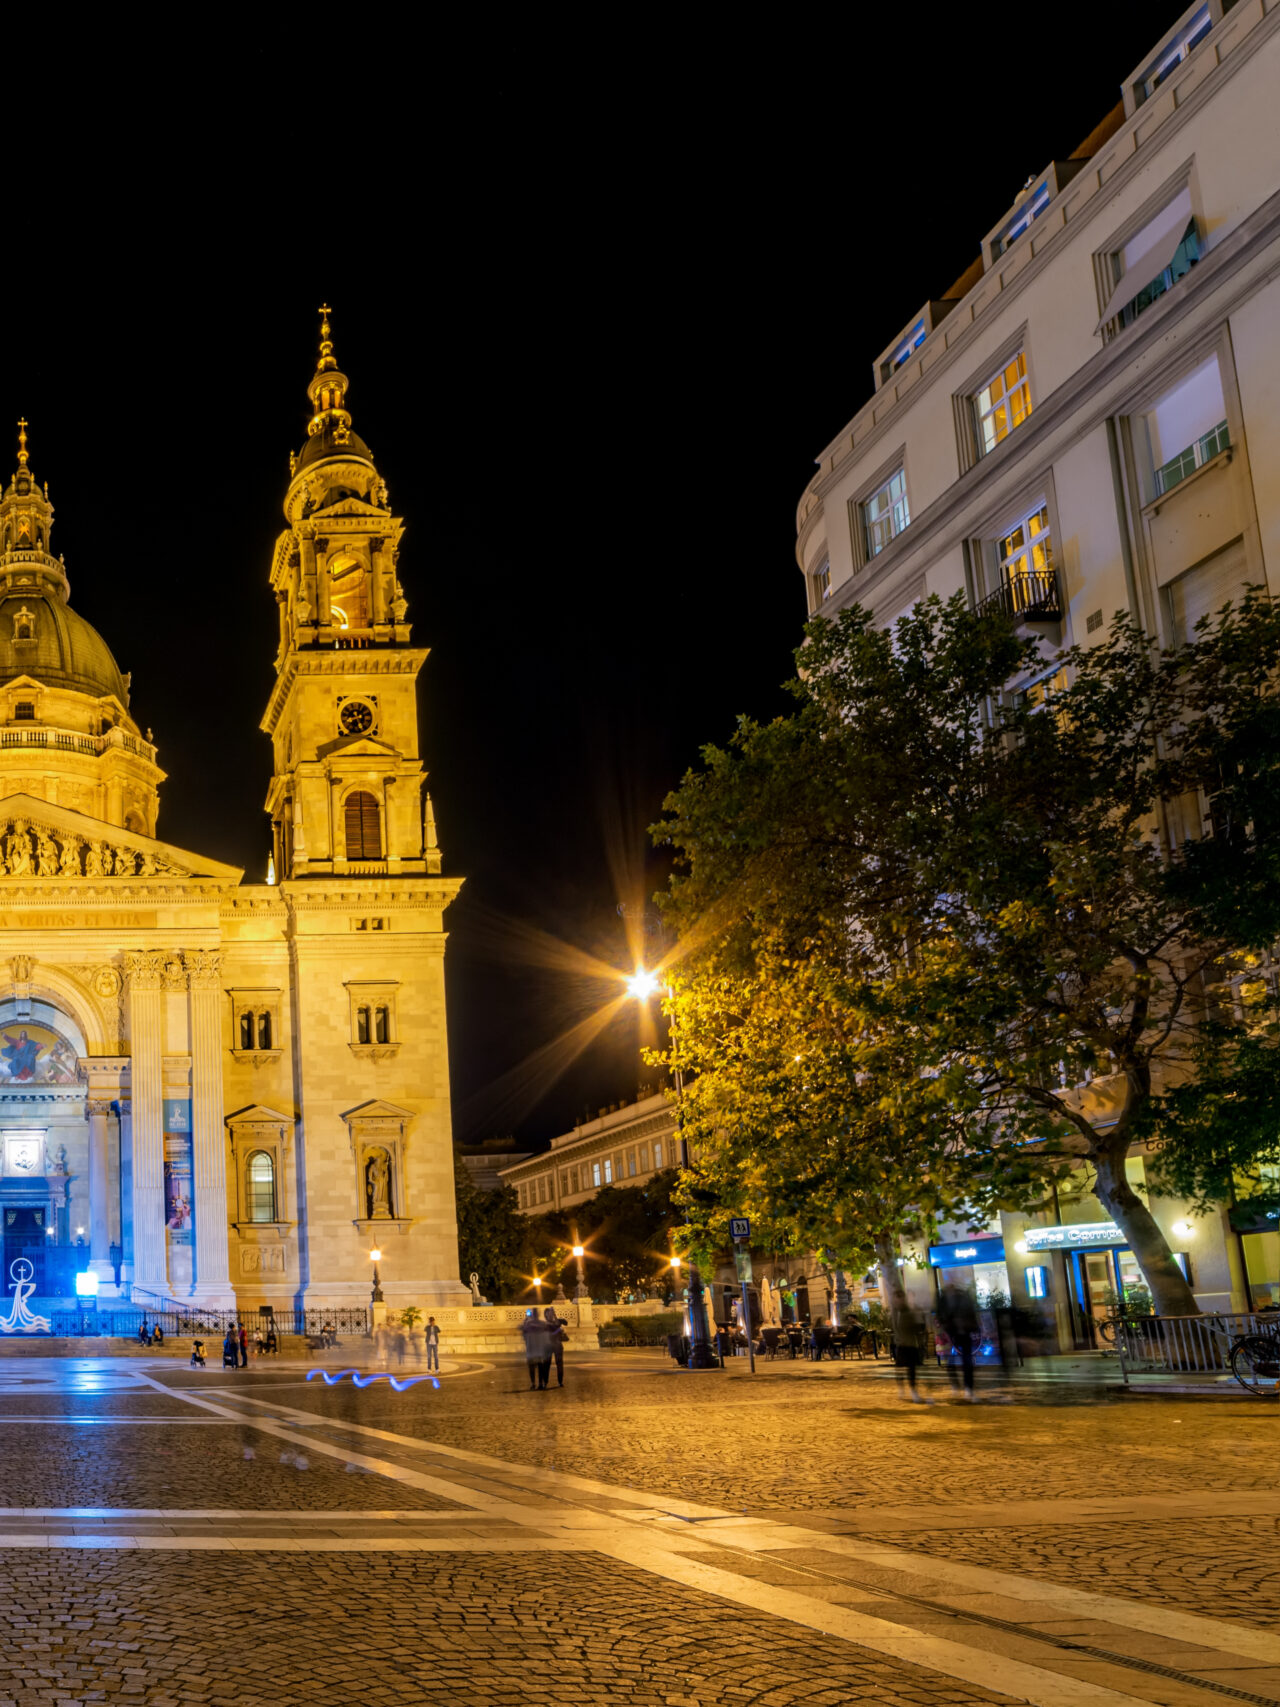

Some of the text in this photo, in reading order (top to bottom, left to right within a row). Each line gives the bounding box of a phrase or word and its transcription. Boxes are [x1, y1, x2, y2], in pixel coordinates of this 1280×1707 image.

[17, 913, 76, 927] VERITAS
[84, 913, 102, 927] ET
[111, 912, 142, 926] VITA
